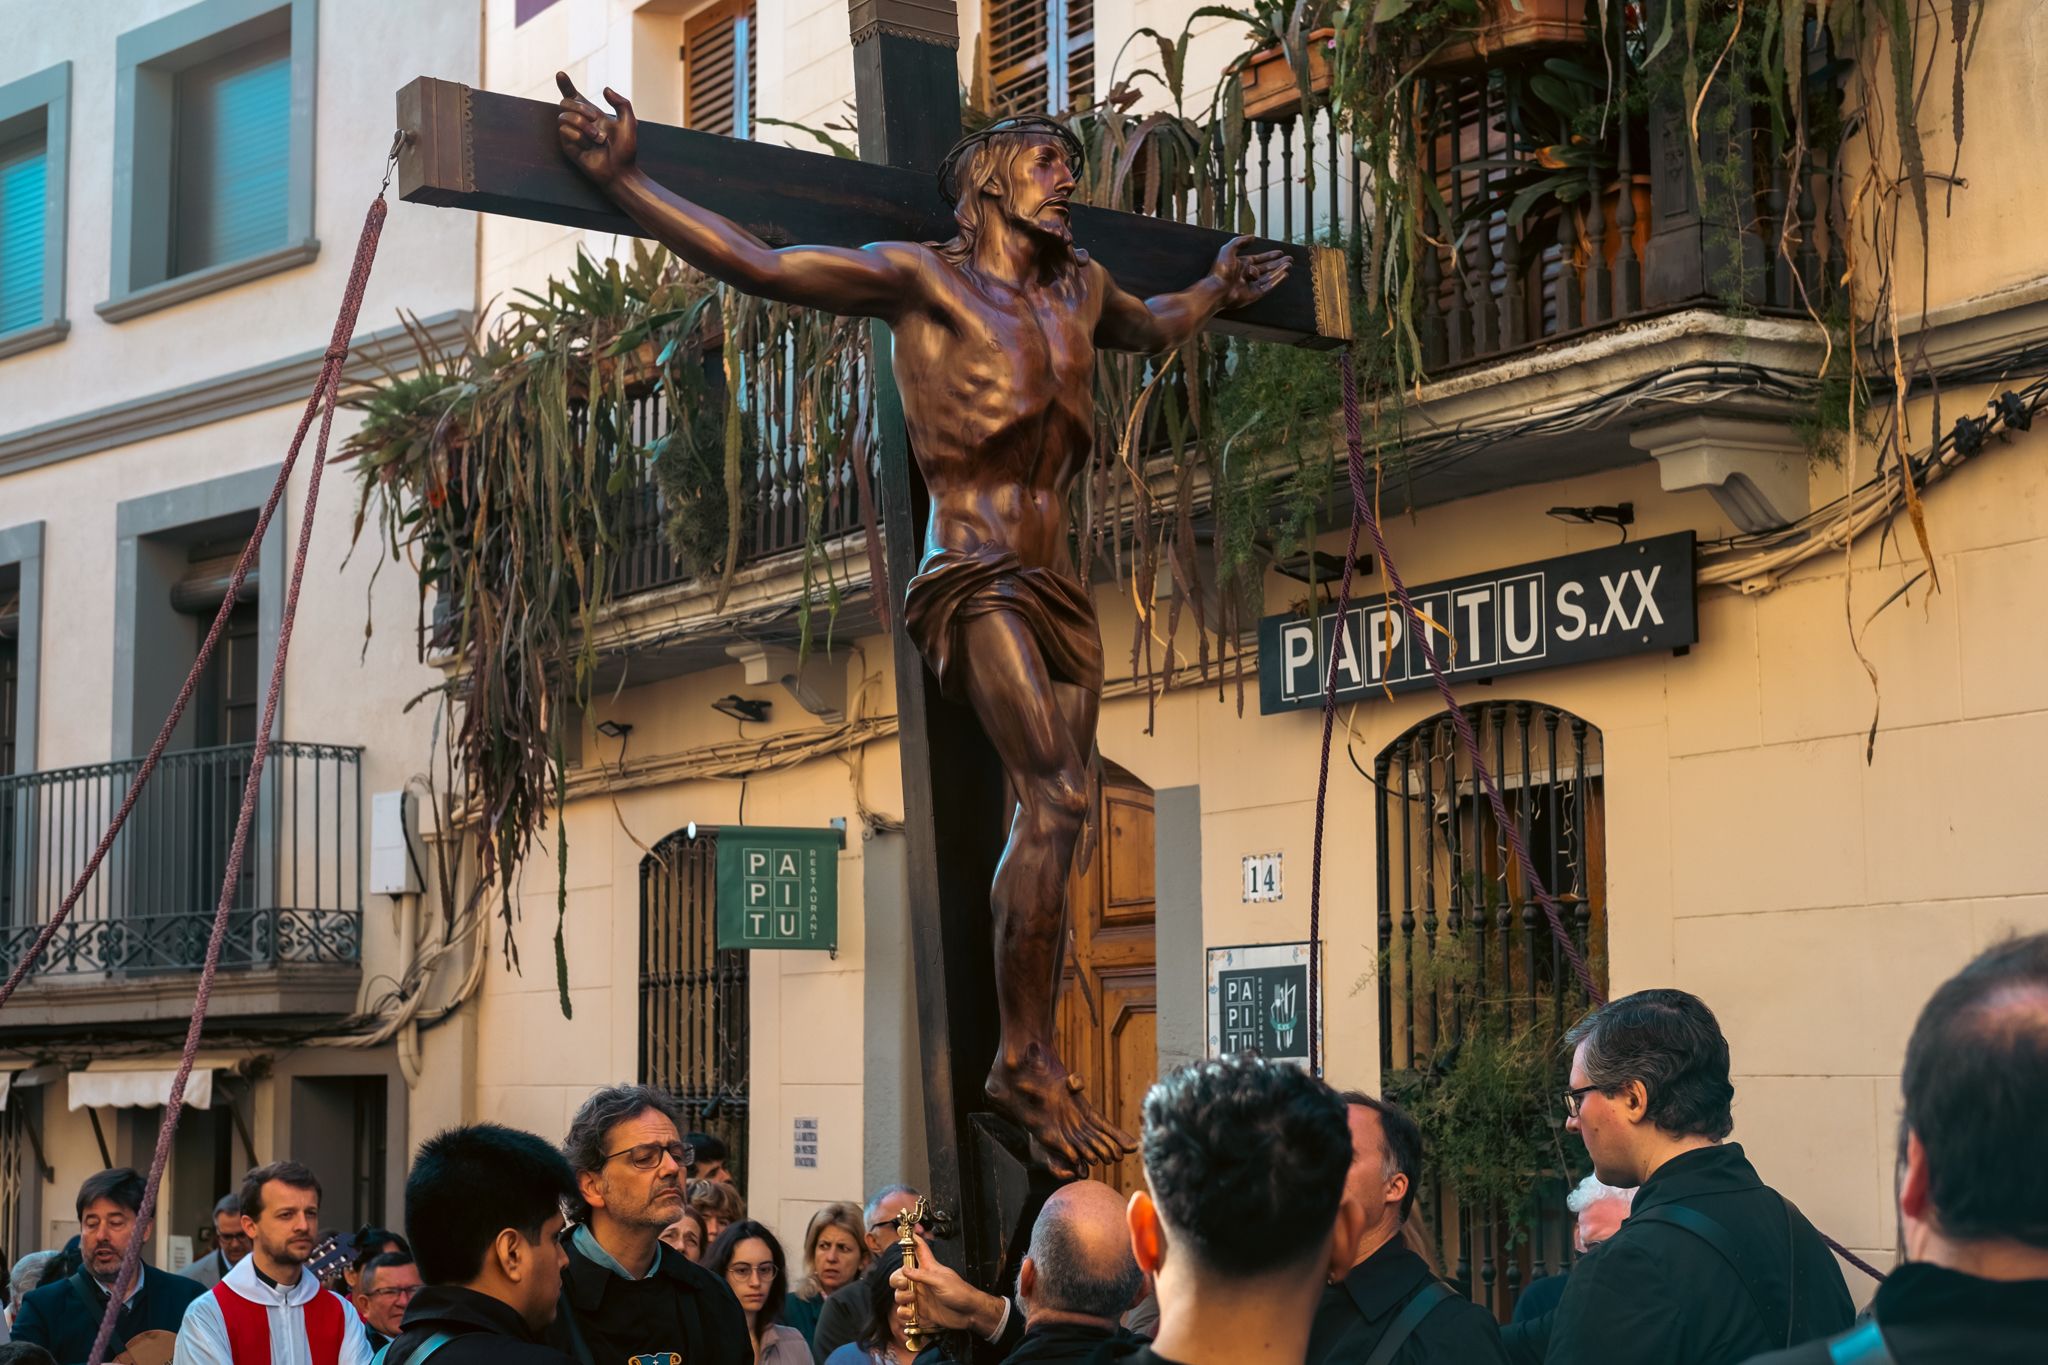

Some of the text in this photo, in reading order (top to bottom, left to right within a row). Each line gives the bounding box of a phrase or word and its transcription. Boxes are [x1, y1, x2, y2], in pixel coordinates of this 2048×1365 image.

[1284, 565, 1664, 694] PAPITU S.XX
[809, 849, 818, 939] RESTAURANT
[1251, 864, 1274, 893] 14
